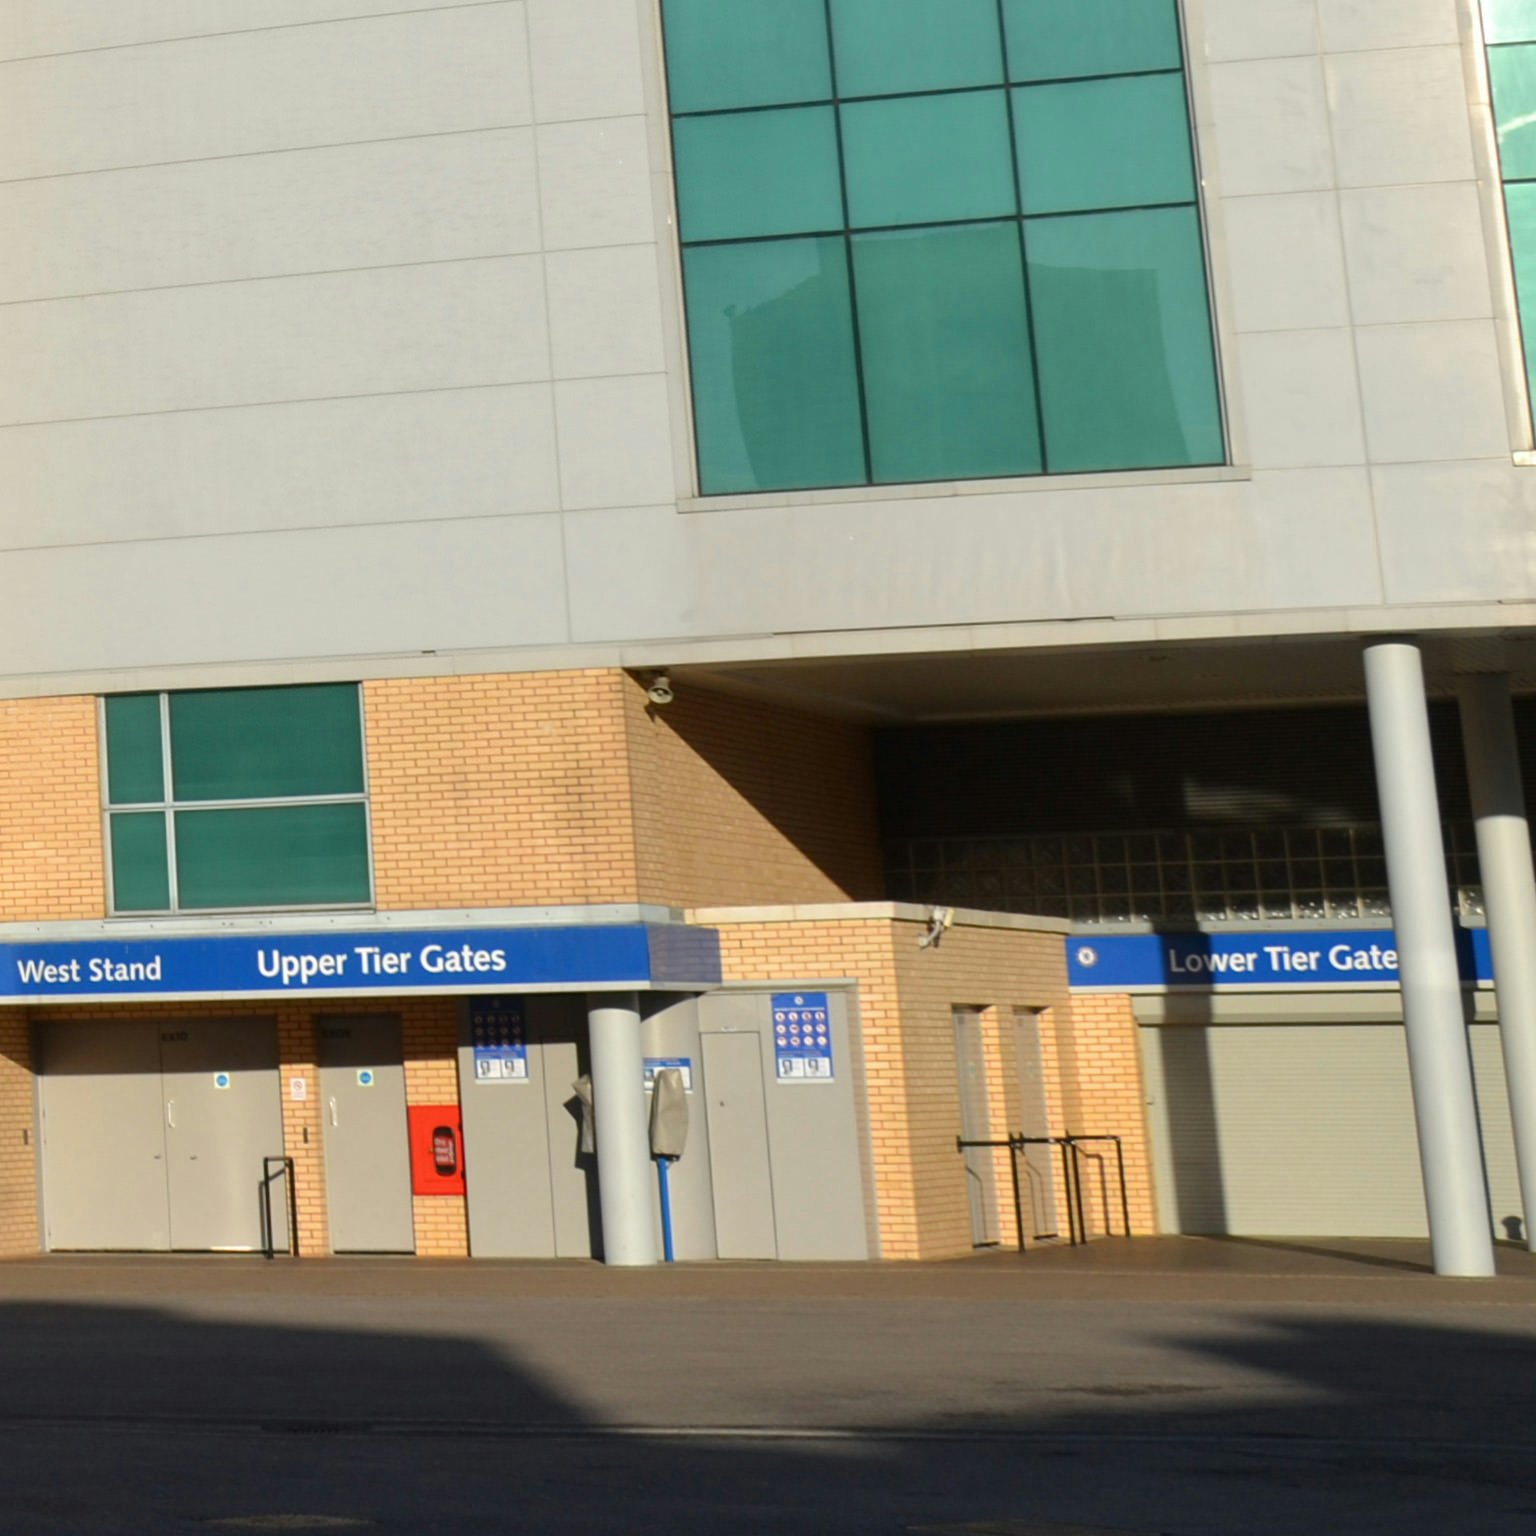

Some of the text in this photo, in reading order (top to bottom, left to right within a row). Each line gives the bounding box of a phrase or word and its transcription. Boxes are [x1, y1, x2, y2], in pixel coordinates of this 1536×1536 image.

[17, 944, 507, 985] West Stand Upper Tier Gates
[1169, 944, 1400, 974] Lower Tier Gate
